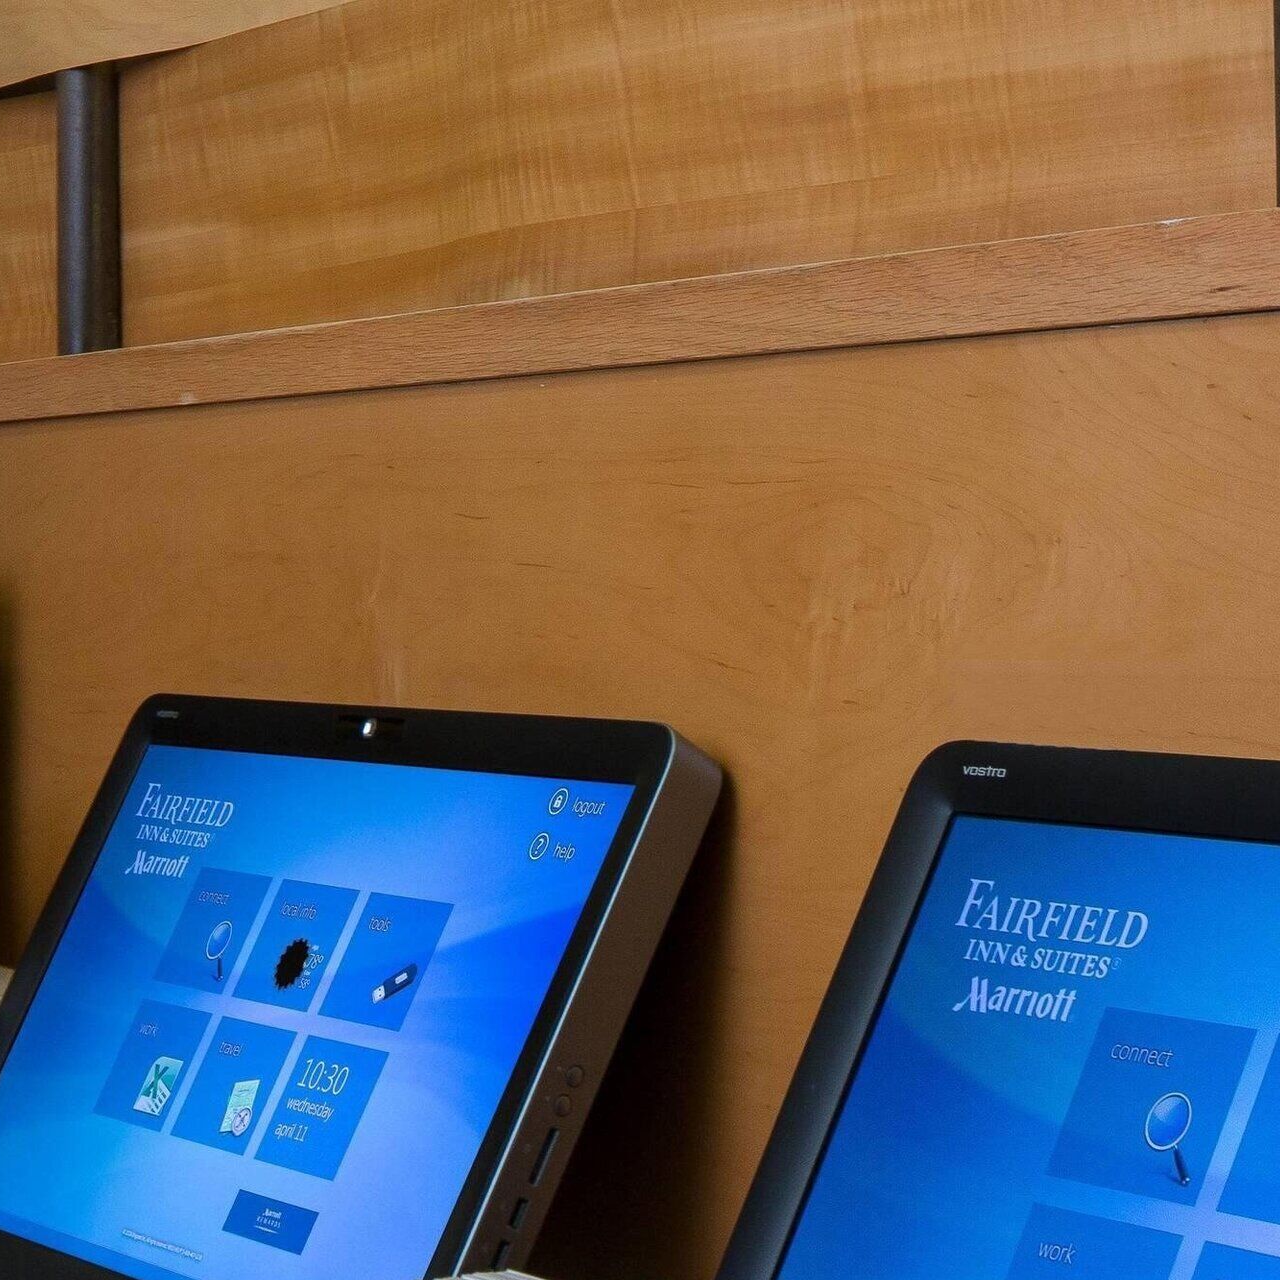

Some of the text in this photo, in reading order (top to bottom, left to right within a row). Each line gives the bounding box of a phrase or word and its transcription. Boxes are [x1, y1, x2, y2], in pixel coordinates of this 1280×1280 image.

[963, 765, 1007, 778] vostro
[136, 782, 234, 828] FAIRFIELD
[572, 796, 607, 818] logout
[136, 823, 162, 841] INN
[124, 849, 190, 878] Marriott
[553, 842, 576, 862] help
[281, 900, 319, 920] local info
[954, 878, 1150, 950] FAIRFIELD
[369, 915, 392, 932] tools
[963, 938, 1013, 964] INN
[1010, 944, 1028, 968] &
[952, 975, 1078, 1023] Marriott
[1110, 1040, 1174, 1068] connect
[296, 1058, 350, 1096] 10:30
[286, 1096, 335, 1123] wednesday
[274, 1121, 309, 1142] april 11
[1038, 1241, 1076, 1265] work
